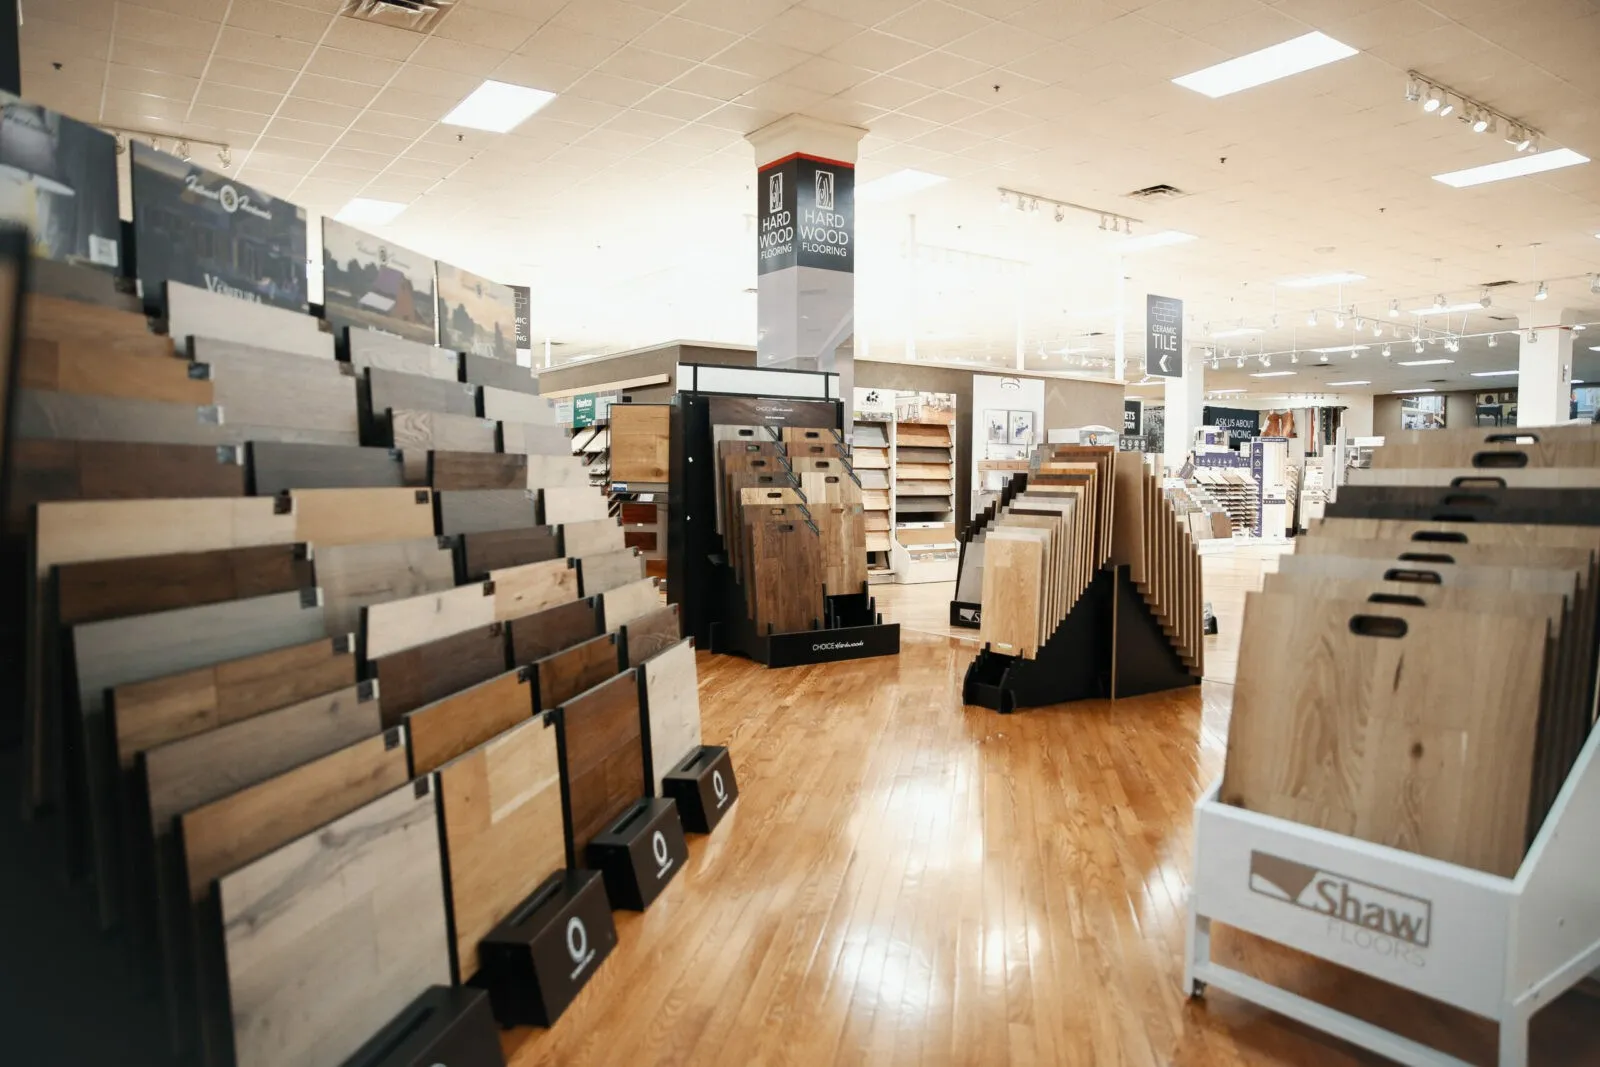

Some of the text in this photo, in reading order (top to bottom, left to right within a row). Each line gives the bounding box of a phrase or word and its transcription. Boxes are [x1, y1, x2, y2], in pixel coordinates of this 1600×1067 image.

[762, 211, 791, 232] HARD
[805, 209, 845, 228] HARD
[760, 227, 794, 248] WOOD
[800, 225, 849, 245] WOOD
[761, 243, 792, 259] FLOORING
[803, 242, 847, 256] FLOORING
[1152, 324, 1177, 335] CERAMIC
[1152, 333, 1177, 351] TILE
[1215, 417, 1254, 428] ASK US ABOUT
[1315, 878, 1423, 943] Shaw
[1326, 919, 1426, 968] FLOORS
